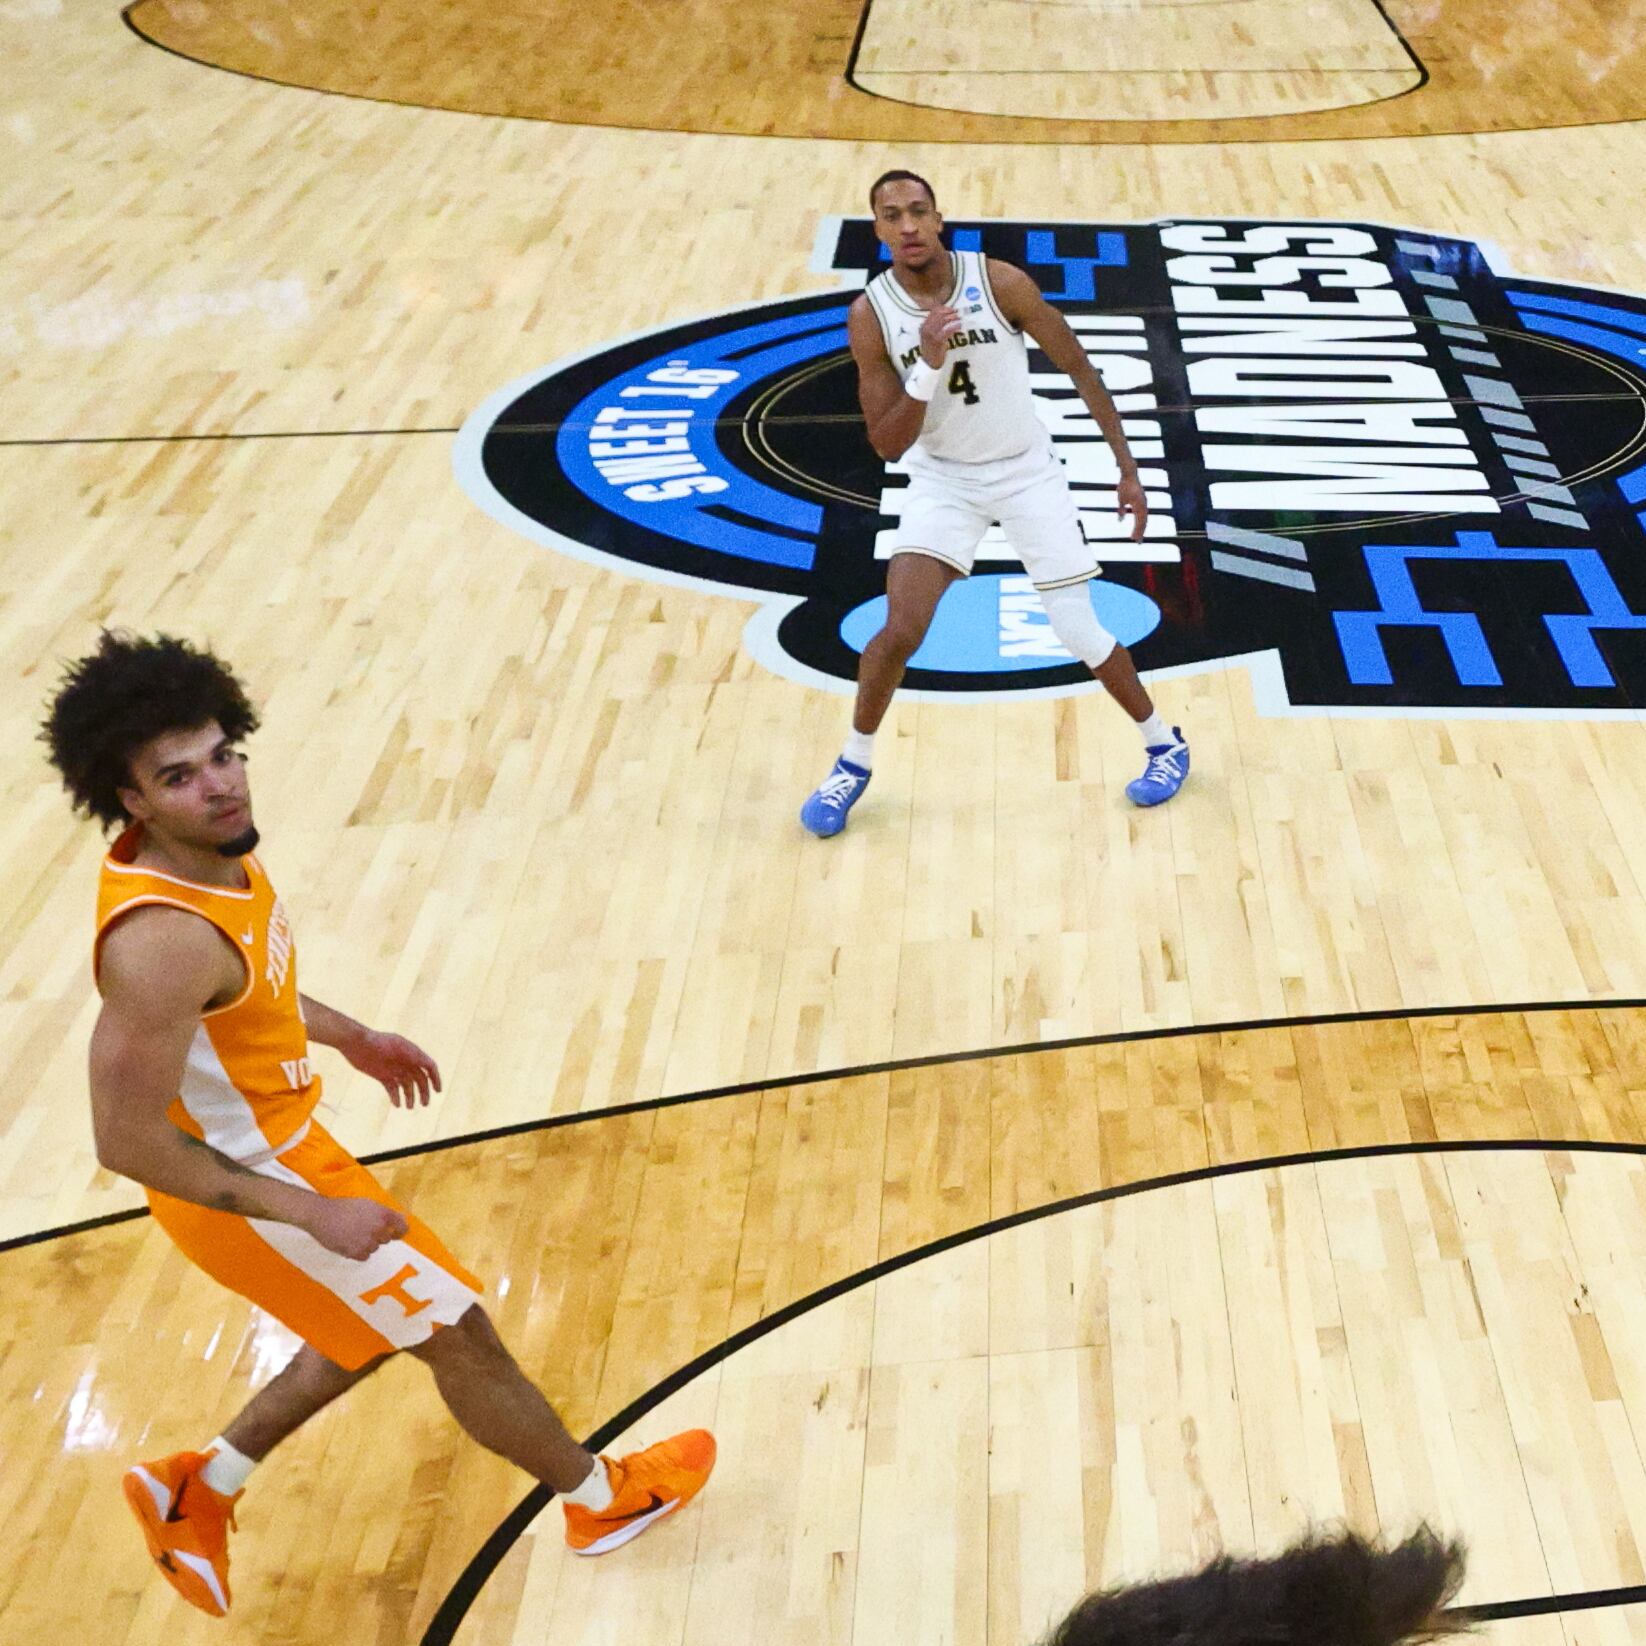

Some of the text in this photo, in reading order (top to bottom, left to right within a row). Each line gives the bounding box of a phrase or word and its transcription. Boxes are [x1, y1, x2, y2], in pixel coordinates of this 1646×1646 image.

[900, 329, 998, 369] MIIGAN
[948, 360, 981, 405] 4
[1158, 223, 1501, 513] MADNESS
[589, 406, 730, 502] SWEET
